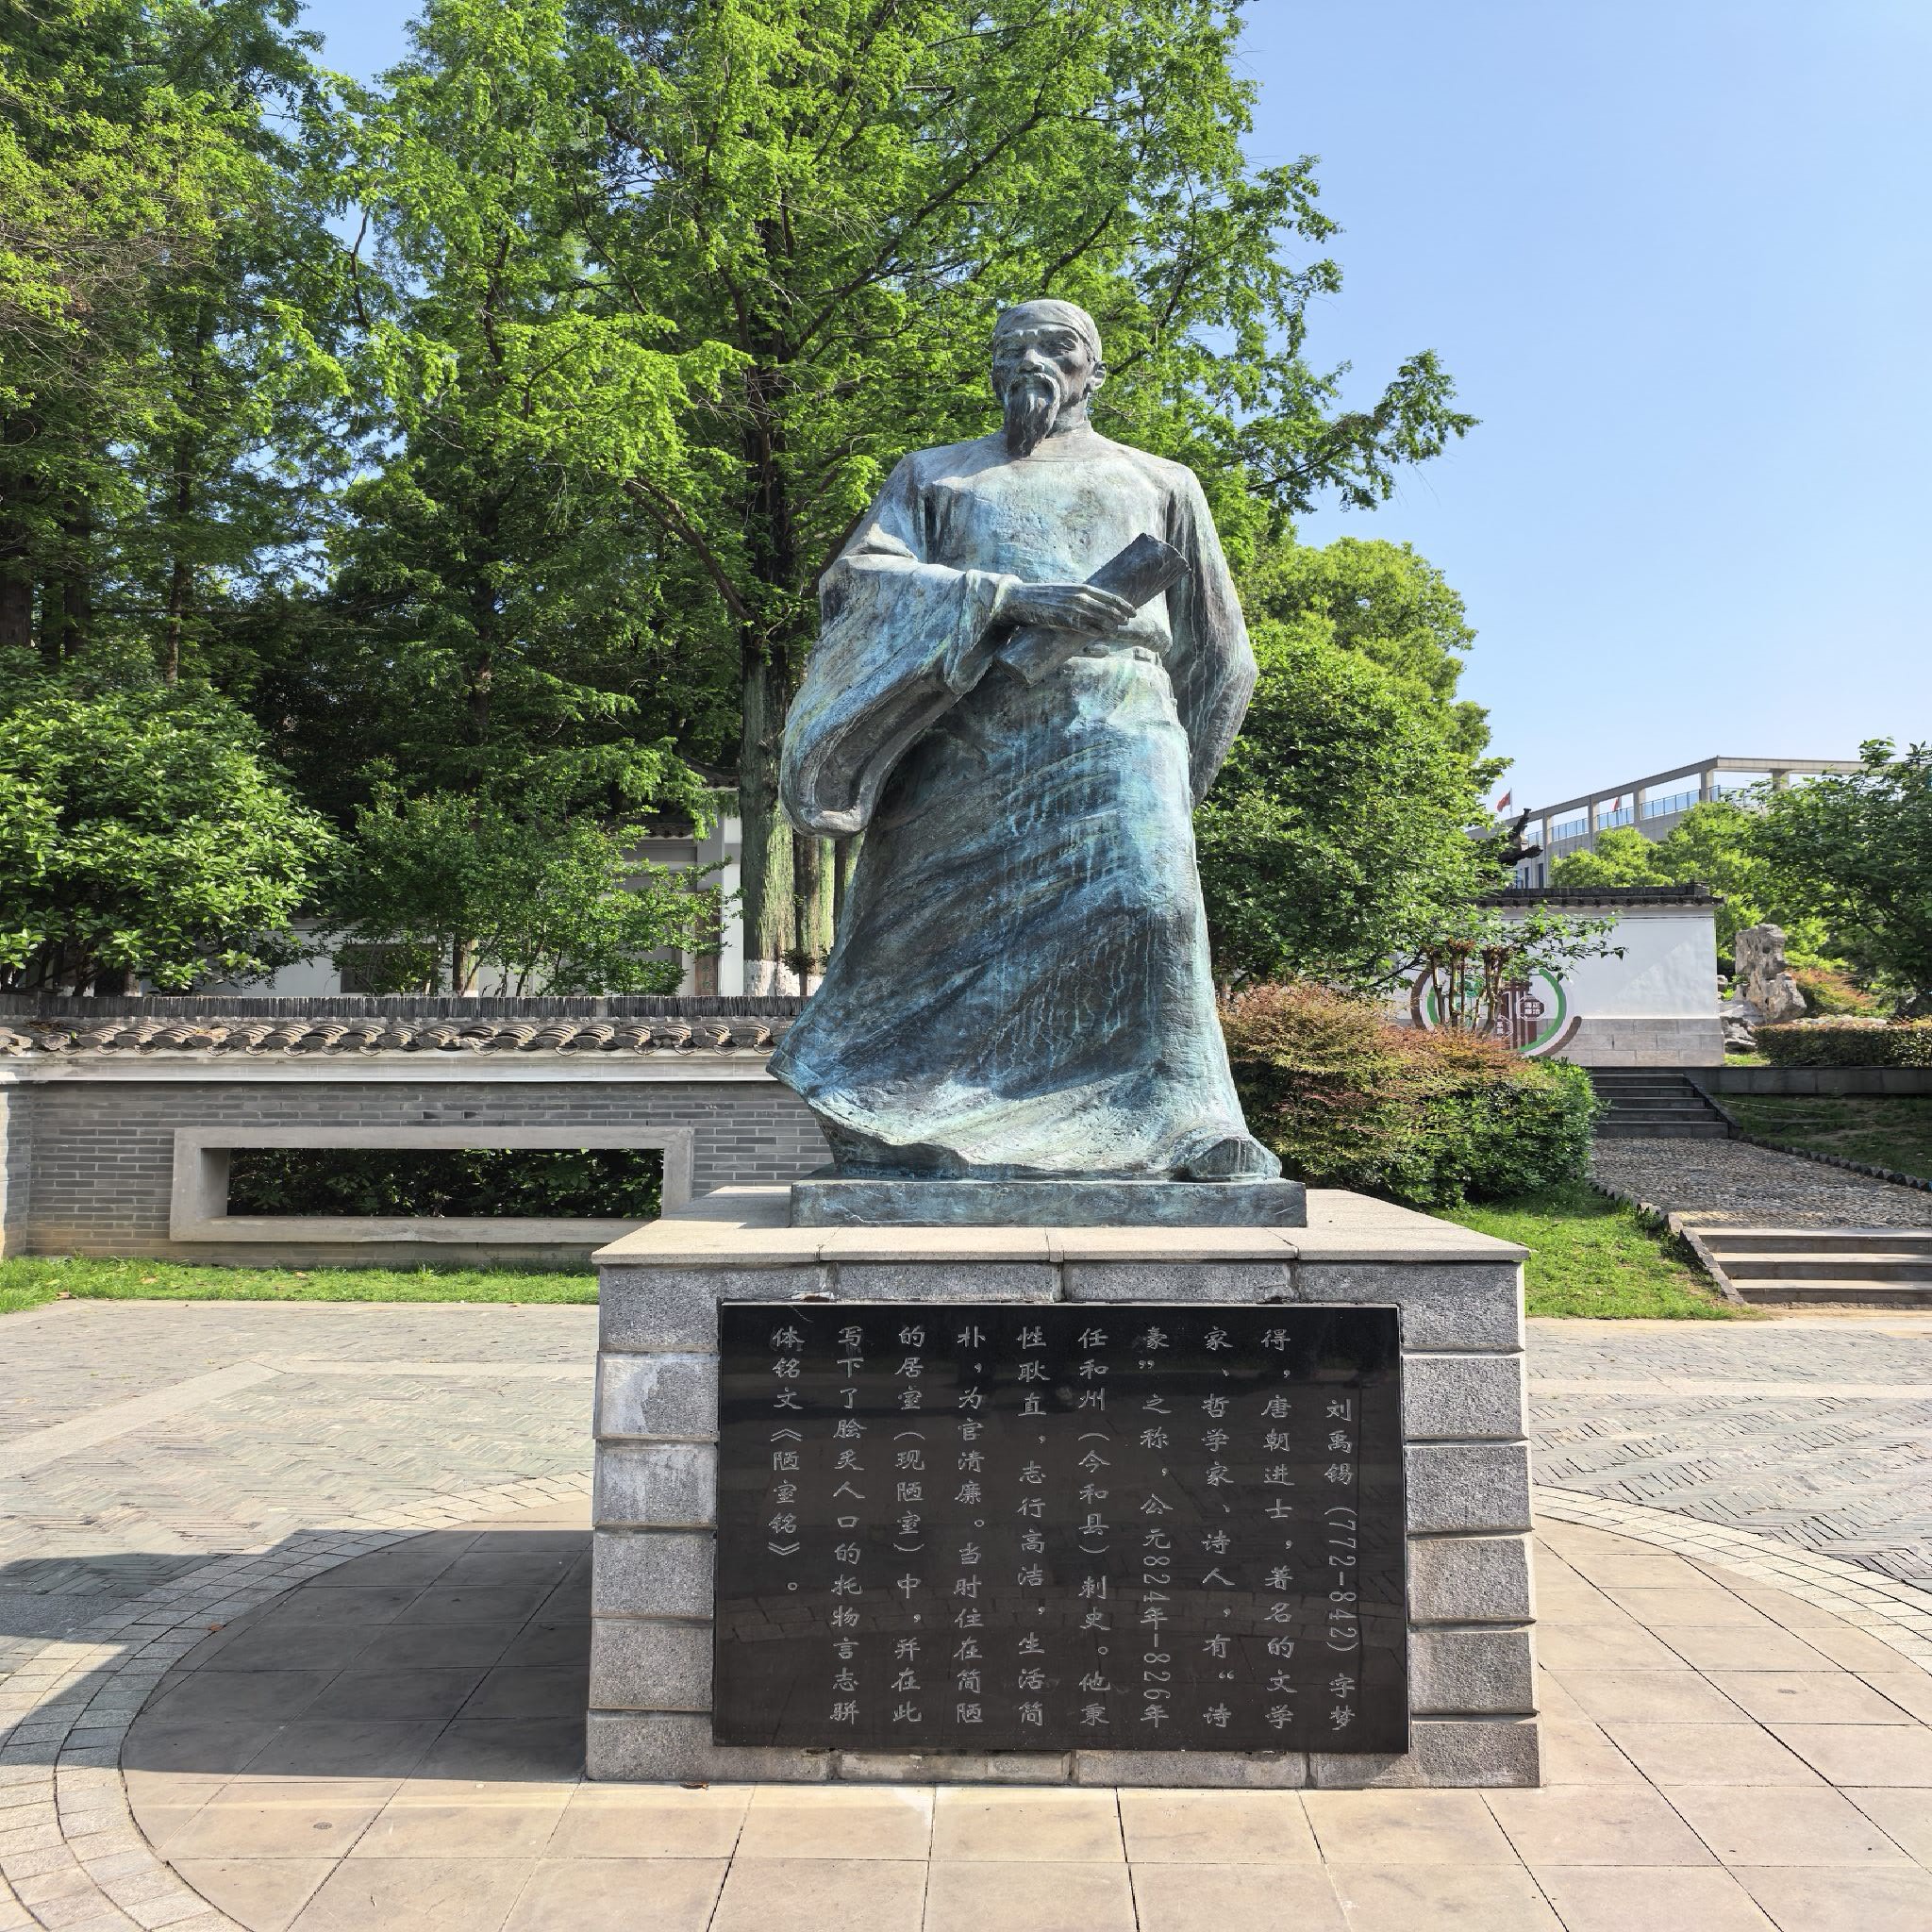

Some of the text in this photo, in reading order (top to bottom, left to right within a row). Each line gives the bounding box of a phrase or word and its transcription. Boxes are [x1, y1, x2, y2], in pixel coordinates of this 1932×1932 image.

[829, 1324, 868, 1725] 写下了脍炙人口的托物言志骈
